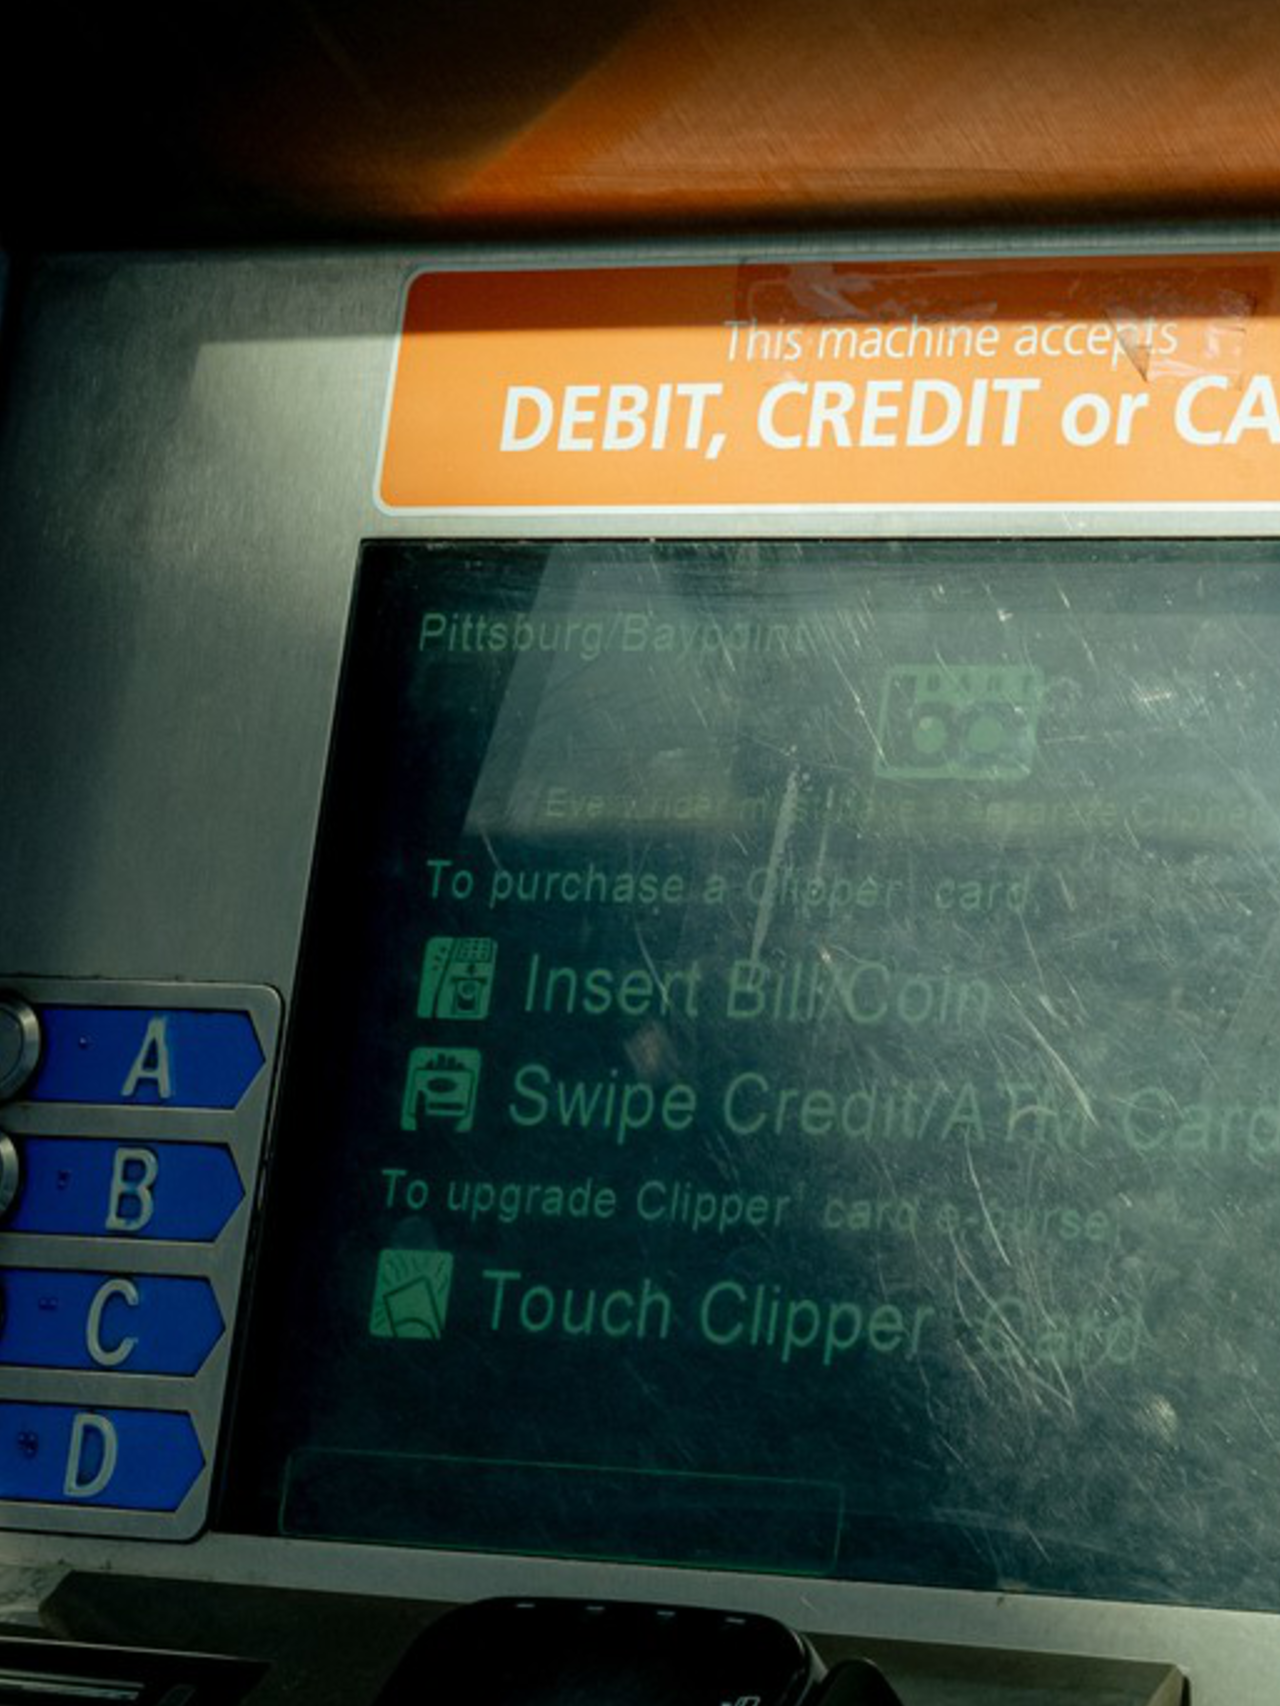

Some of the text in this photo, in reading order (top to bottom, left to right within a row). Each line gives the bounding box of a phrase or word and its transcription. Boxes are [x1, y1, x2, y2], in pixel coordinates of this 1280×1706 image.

[722, 317, 1180, 372] This machine accepts
[498, 382, 728, 461] DEBIT,
[755, 377, 1041, 451] CREDIT
[1060, 391, 1150, 448] or
[428, 860, 473, 899] To
[489, 864, 685, 909] purchase
[705, 876, 723, 904] a
[934, 870, 1031, 913] card
[524, 953, 699, 1019] Insert
[121, 1016, 173, 1099] A
[509, 1063, 698, 1146] Swipe
[105, 1146, 159, 1232] B
[381, 1167, 429, 1209] To
[448, 1178, 617, 1224] upgrade
[86, 1278, 139, 1368] C
[483, 1268, 672, 1340] Touch
[64, 1411, 118, 1498] D
